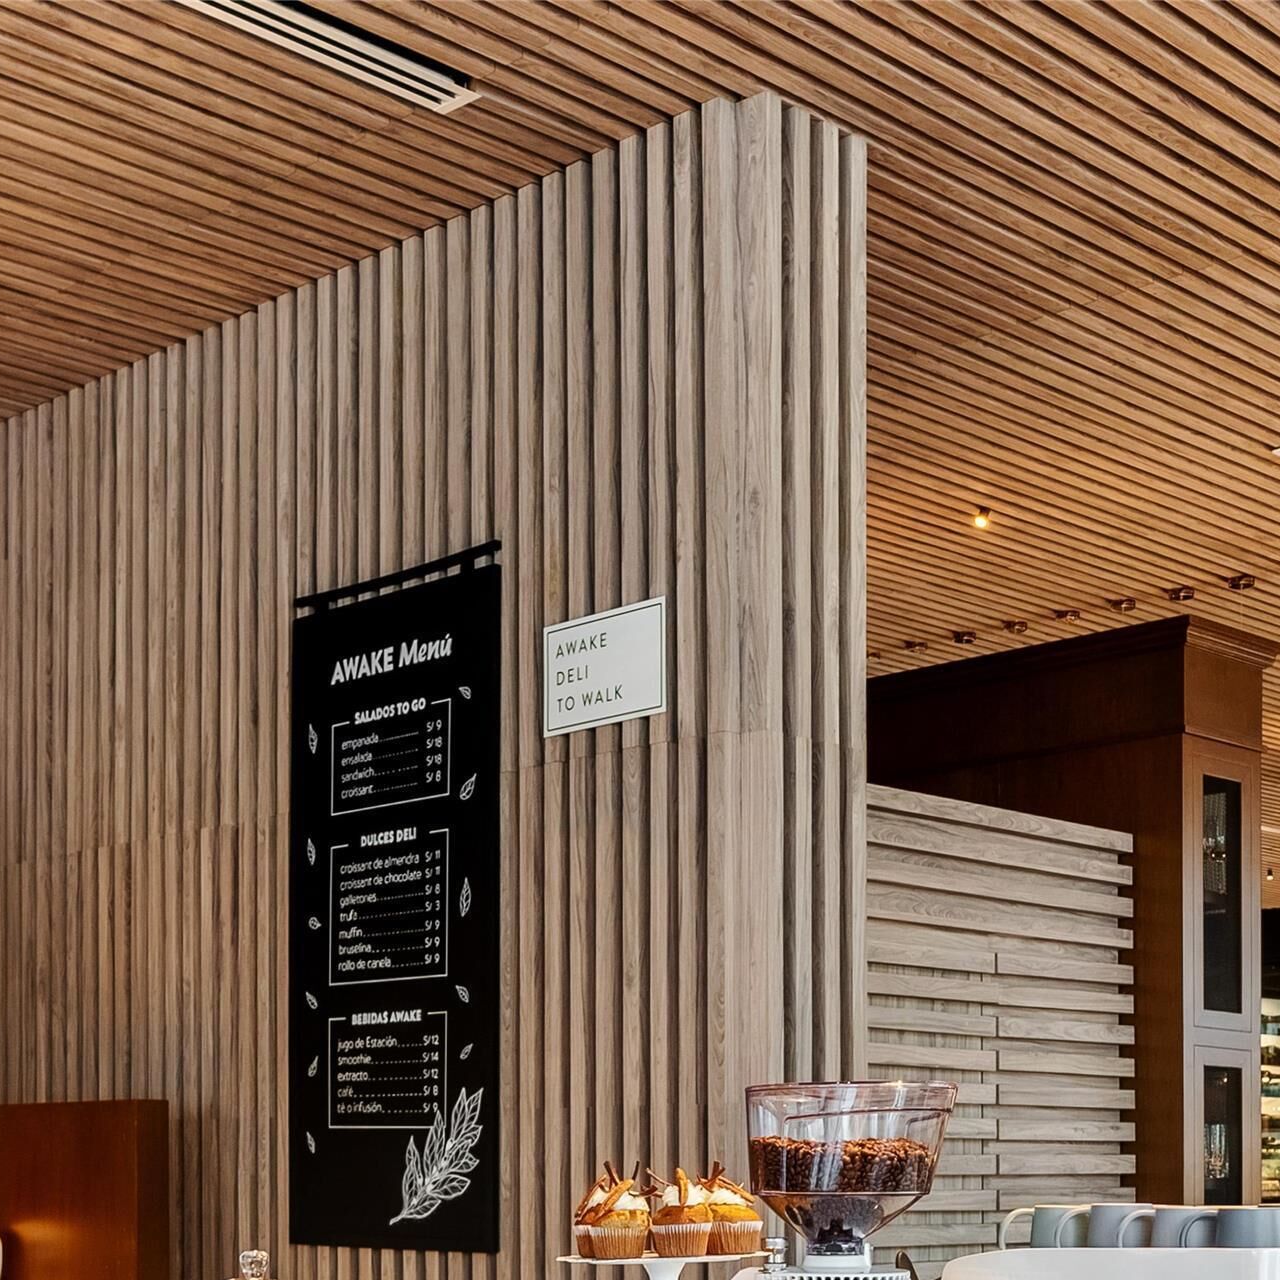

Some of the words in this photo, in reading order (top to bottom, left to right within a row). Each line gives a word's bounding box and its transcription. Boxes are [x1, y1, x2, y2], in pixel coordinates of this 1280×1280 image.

[555, 632, 608, 659] AWAKE
[330, 646, 394, 686] AWAKE
[398, 633, 453, 669] Menú
[556, 665, 589, 686] DELI
[556, 695, 575, 713] TO
[581, 684, 623, 707] WALK
[354, 704, 395, 725] SALADOS
[396, 701, 410, 715] TO
[411, 697, 426, 712] GO
[341, 732, 379, 751] empanada
[341, 751, 372, 767] ensalada
[341, 766, 375, 783] sandwich
[341, 784, 374, 800] croissant
[360, 830, 394, 847] DULCES
[396, 826, 417, 843] DELI
[340, 861, 372, 875] croissant
[373, 858, 384, 870] de
[384, 852, 420, 868] almendra
[340, 877, 372, 892] croissant
[373, 873, 384, 886] de
[384, 869, 422, 885] chocolate
[339, 909, 358, 923] trufa
[338, 926, 363, 940] muffin
[337, 960, 356, 972] rollo
[356, 959, 366, 970] de
[367, 956, 392, 969] canela
[351, 1011, 388, 1026] BEBIDAS
[389, 1009, 422, 1023] AWAKE
[337, 1038, 354, 1053] jugo
[354, 1037, 365, 1049] de
[365, 1035, 398, 1048] Estación
[337, 1053, 372, 1066] smoothie
[337, 1071, 369, 1082] extracto
